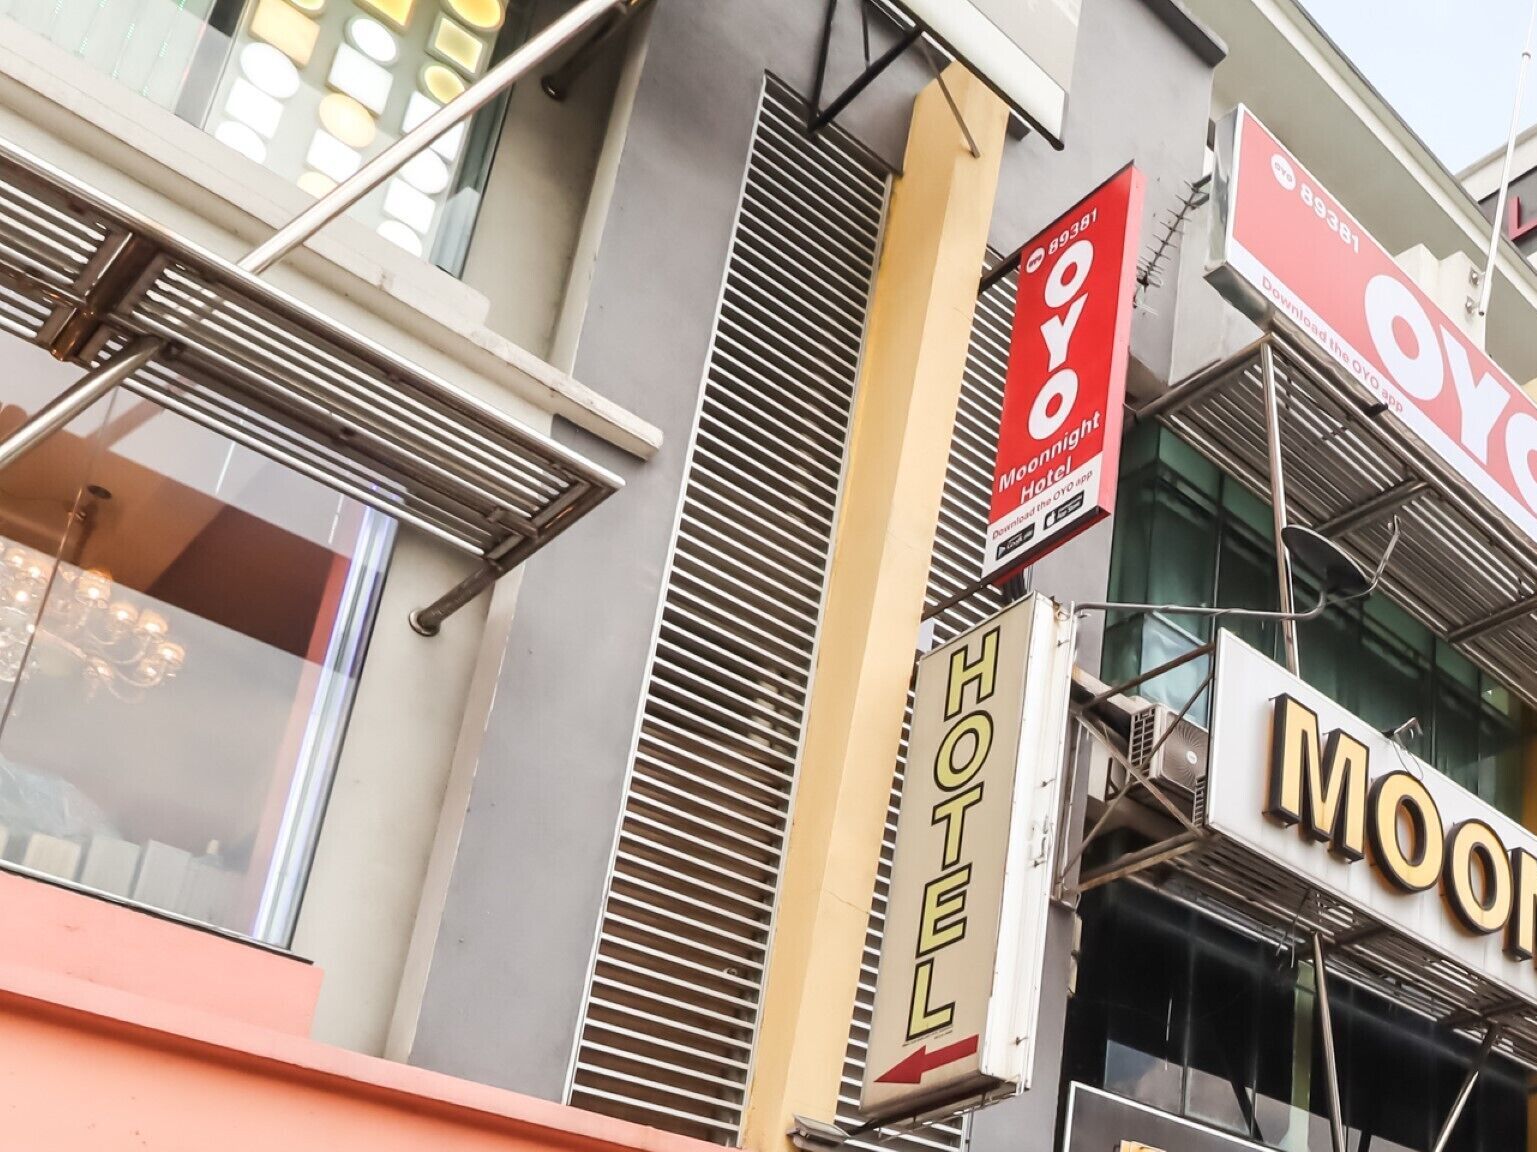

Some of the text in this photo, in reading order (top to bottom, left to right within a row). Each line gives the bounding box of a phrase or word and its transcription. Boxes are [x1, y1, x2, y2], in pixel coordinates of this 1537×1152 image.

[1048, 208, 1097, 255] 89381
[1300, 183, 1360, 254] 89381
[1028, 240, 1094, 441] OYO
[1262, 275, 1403, 414] Download the OYO app
[999, 411, 1100, 493] Moonnight
[1021, 456, 1072, 504] Hotel
[992, 507, 1039, 540] Download
[1037, 497, 1052, 512] the
[1053, 482, 1074, 501] OYO
[1075, 471, 1093, 486] app
[905, 626, 1000, 1042] HOTEL
